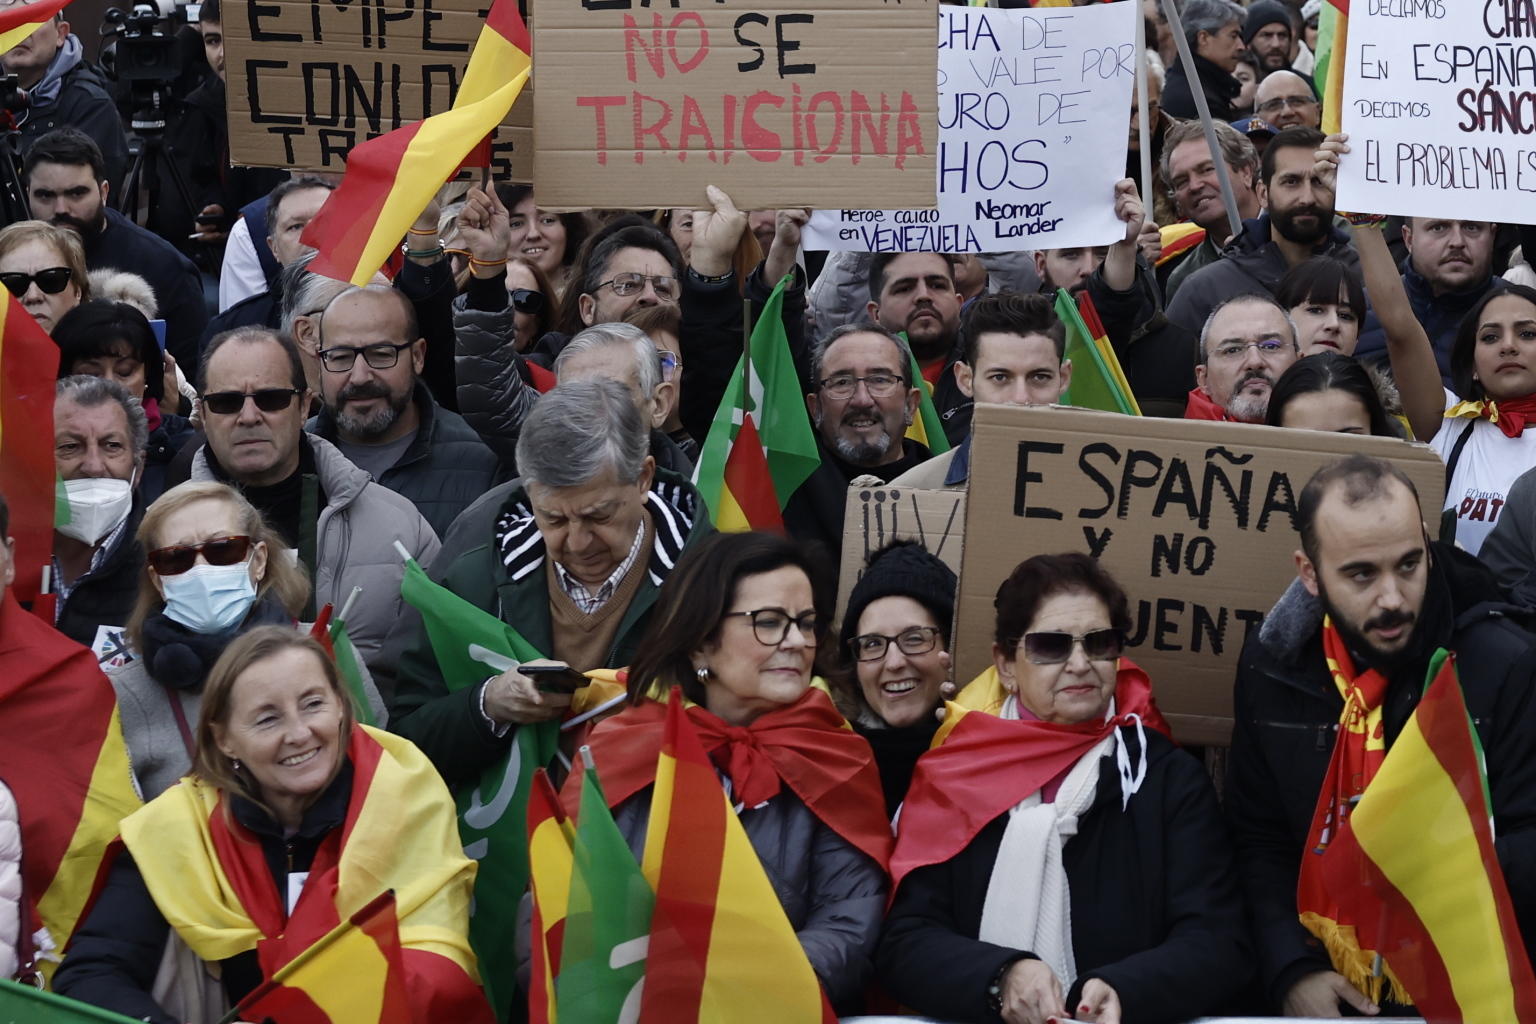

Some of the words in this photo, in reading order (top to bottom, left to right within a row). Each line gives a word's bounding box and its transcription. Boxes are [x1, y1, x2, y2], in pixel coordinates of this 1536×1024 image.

[623, 11, 709, 82] NO
[732, 12, 817, 79] SE
[1021, 15, 1074, 51] DE
[969, 55, 1064, 89] VALE
[1081, 43, 1136, 83] POR
[938, 92, 1010, 131] URO
[1038, 90, 1092, 126] DE
[1353, 99, 1431, 120] DECIMOS
[939, 138, 1049, 194] HOS
[1365, 139, 1389, 184] EL
[1396, 142, 1507, 190] PROBLEMA
[975, 199, 1052, 221] Neomar
[839, 228, 860, 241] en
[860, 223, 983, 253] VENEZUELA
[994, 217, 1064, 239] Lander
[1014, 440, 1301, 533] ESPAÑA
[1457, 496, 1505, 523] PAT
[1082, 526, 1115, 559] Y
[1151, 532, 1217, 578] NO
